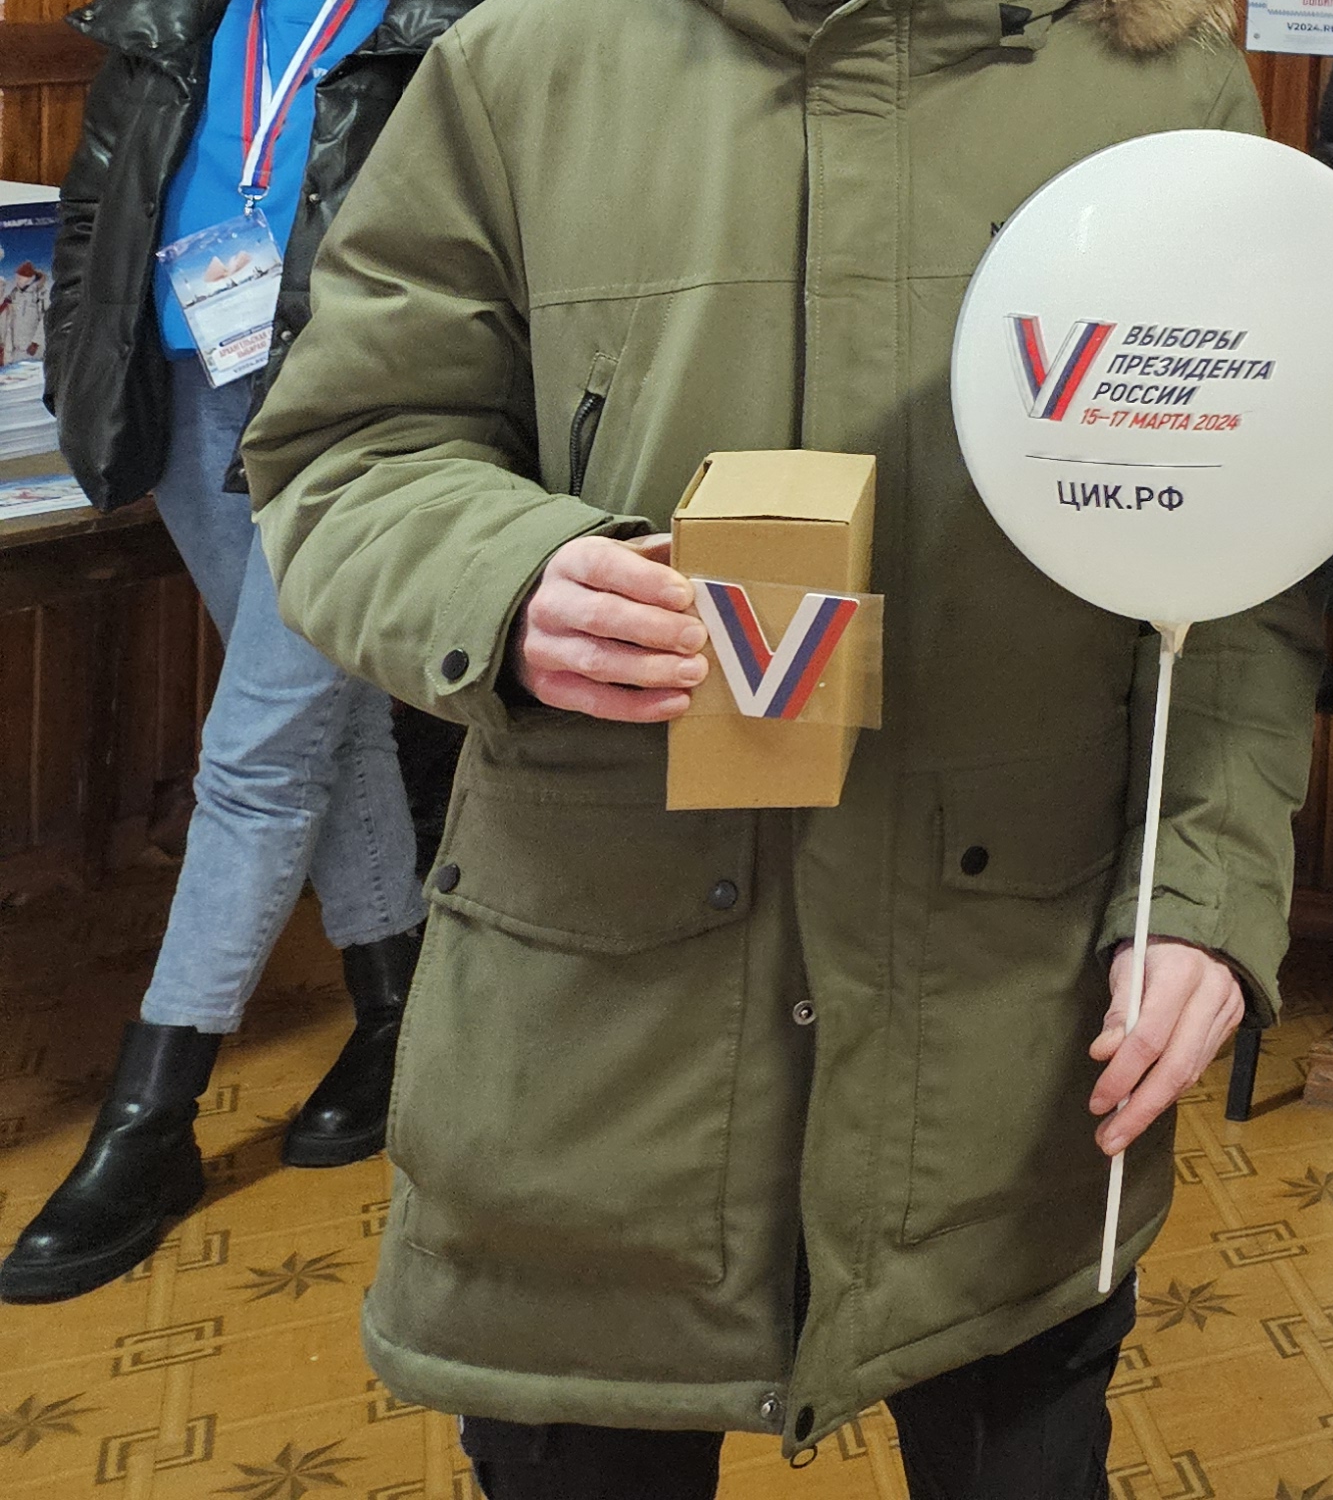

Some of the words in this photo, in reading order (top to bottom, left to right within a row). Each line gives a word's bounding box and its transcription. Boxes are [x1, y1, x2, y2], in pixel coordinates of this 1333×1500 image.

[1122, 324, 1248, 351] ВЫБОРЫ
[1106, 353, 1275, 381] ПРЕЗИДЕНТА
[1092, 382, 1198, 406] РОССИИ
[1129, 414, 1190, 431] МАРТА
[1192, 414, 1241, 431] 2024
[1057, 480, 1184, 512] ЦИК.РФ
